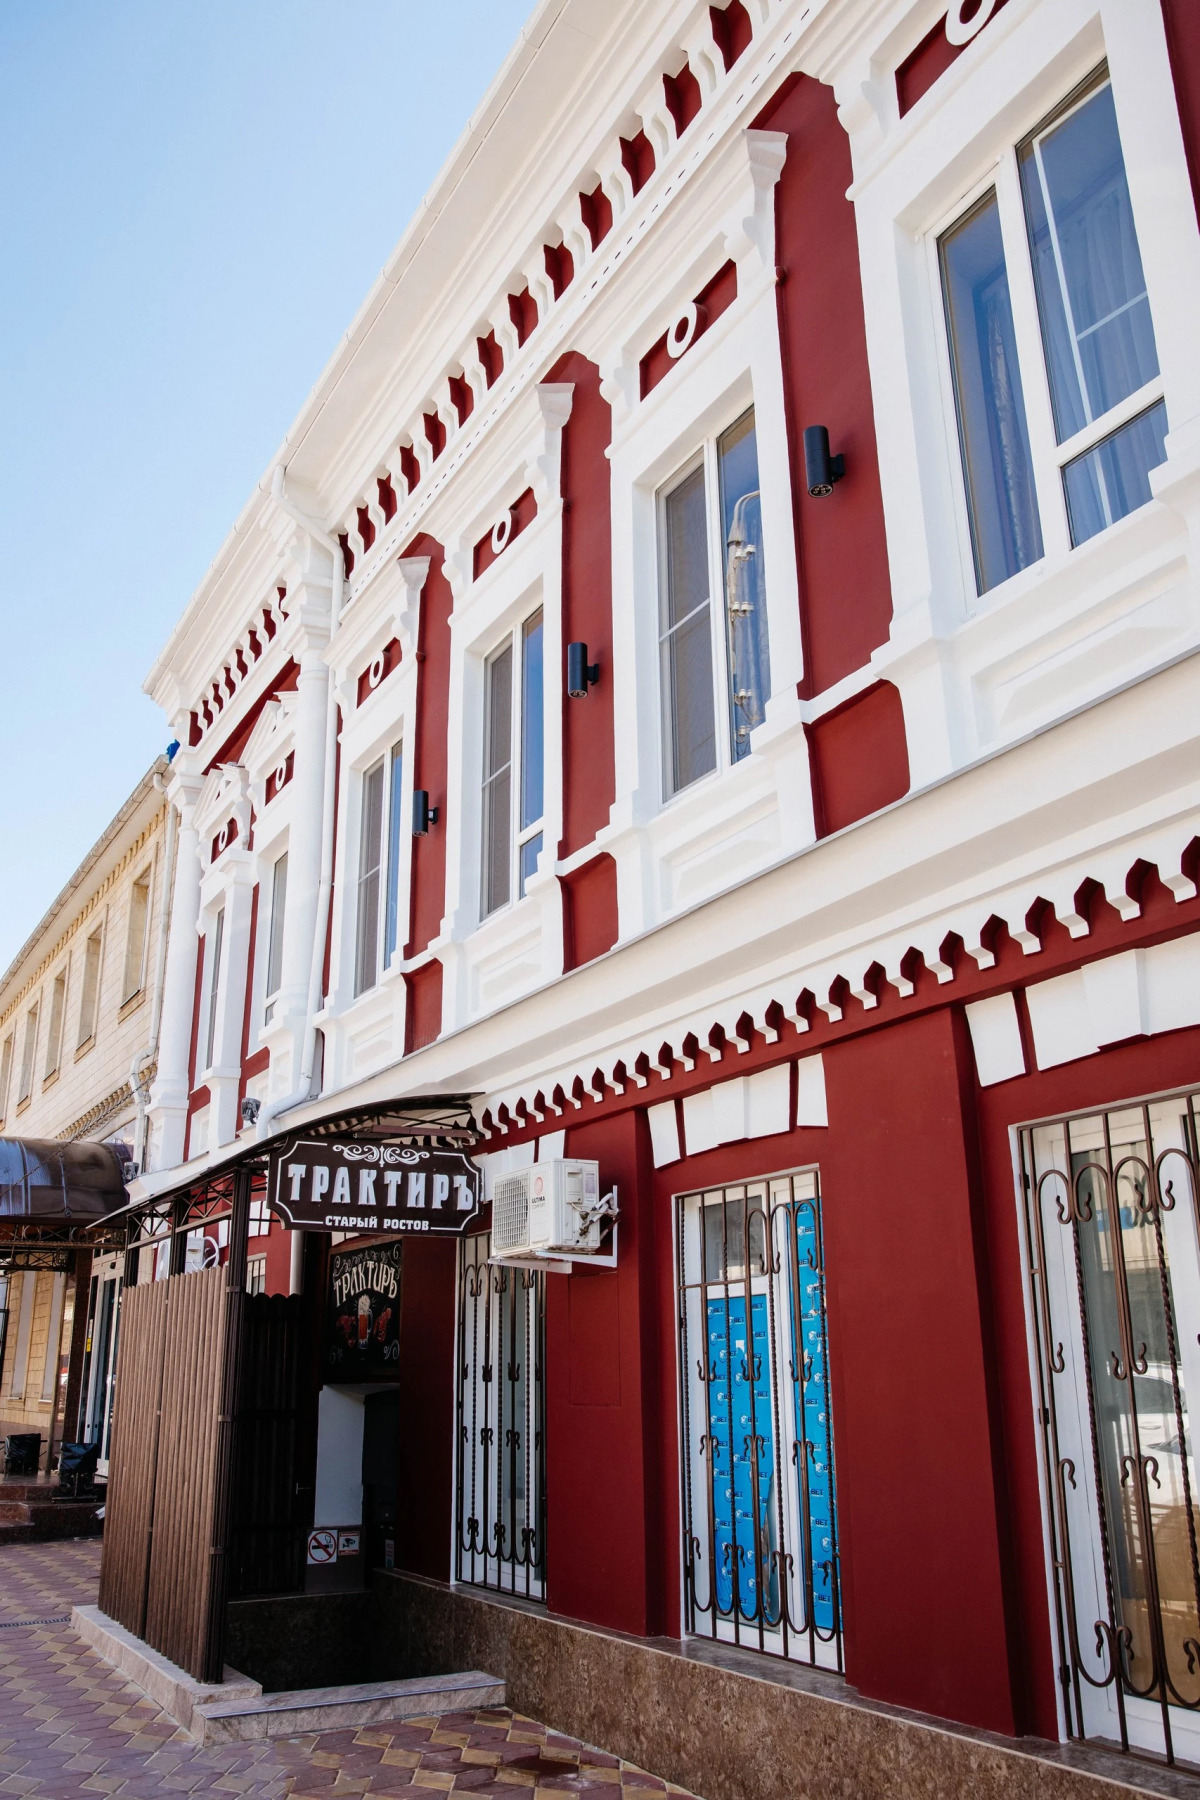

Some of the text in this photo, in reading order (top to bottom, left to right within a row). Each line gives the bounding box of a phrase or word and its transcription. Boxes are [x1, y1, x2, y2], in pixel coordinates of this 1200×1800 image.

[287, 1163, 474, 1211] ТРАКТИРЪ
[325, 1215, 430, 1231] СТАРЫЙ РОСТОВ
[333, 1260, 398, 1307] ТРАКТИРЪ
[815, 1518, 828, 1526] BET
[818, 1594, 831, 1602] BET
